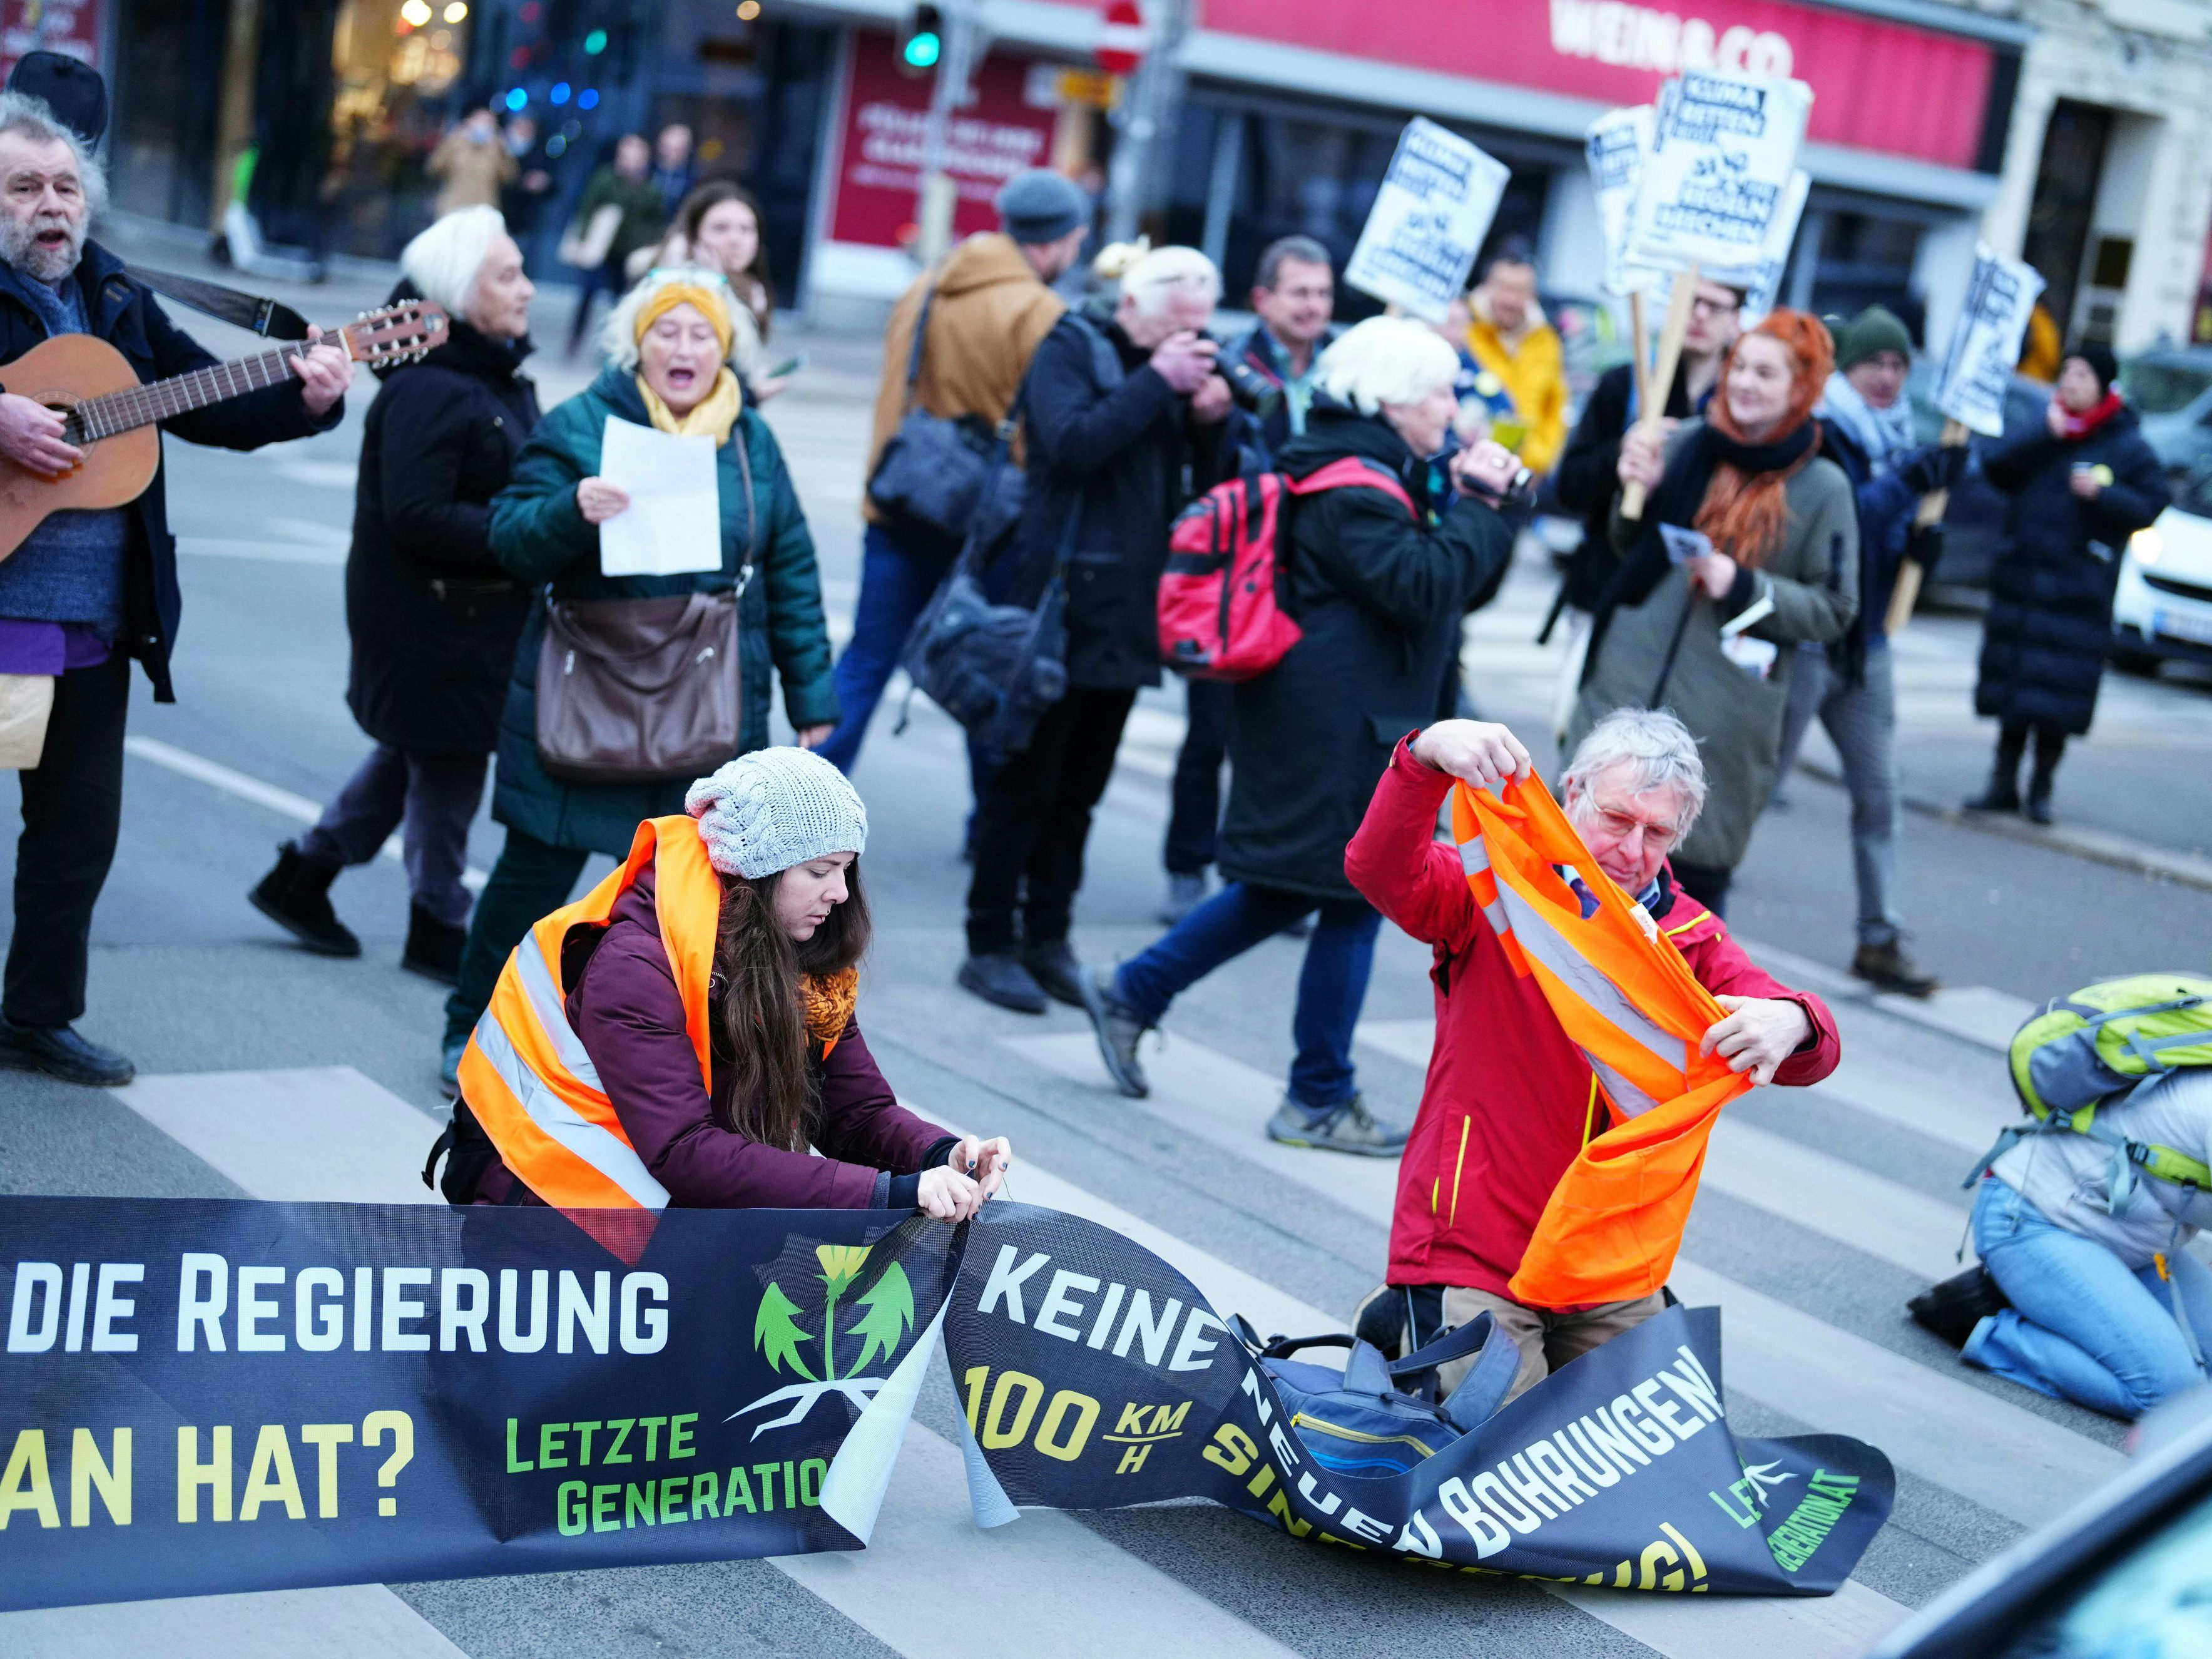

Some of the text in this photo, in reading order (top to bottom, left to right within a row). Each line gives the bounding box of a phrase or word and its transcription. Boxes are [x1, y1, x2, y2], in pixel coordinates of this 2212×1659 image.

[7, 1252, 670, 1355] DIE REGIERUNG
[977, 1244, 1231, 1372] KEINE
[178, 1411, 414, 1524] HAT?
[506, 1412, 699, 1473] LETZTE
[964, 1365, 1101, 1462] 100
[1438, 1344, 1725, 1559] BOHRUNGEN
[557, 1456, 836, 1536] GENERATIO
[1202, 1423, 1367, 1551] SIN
